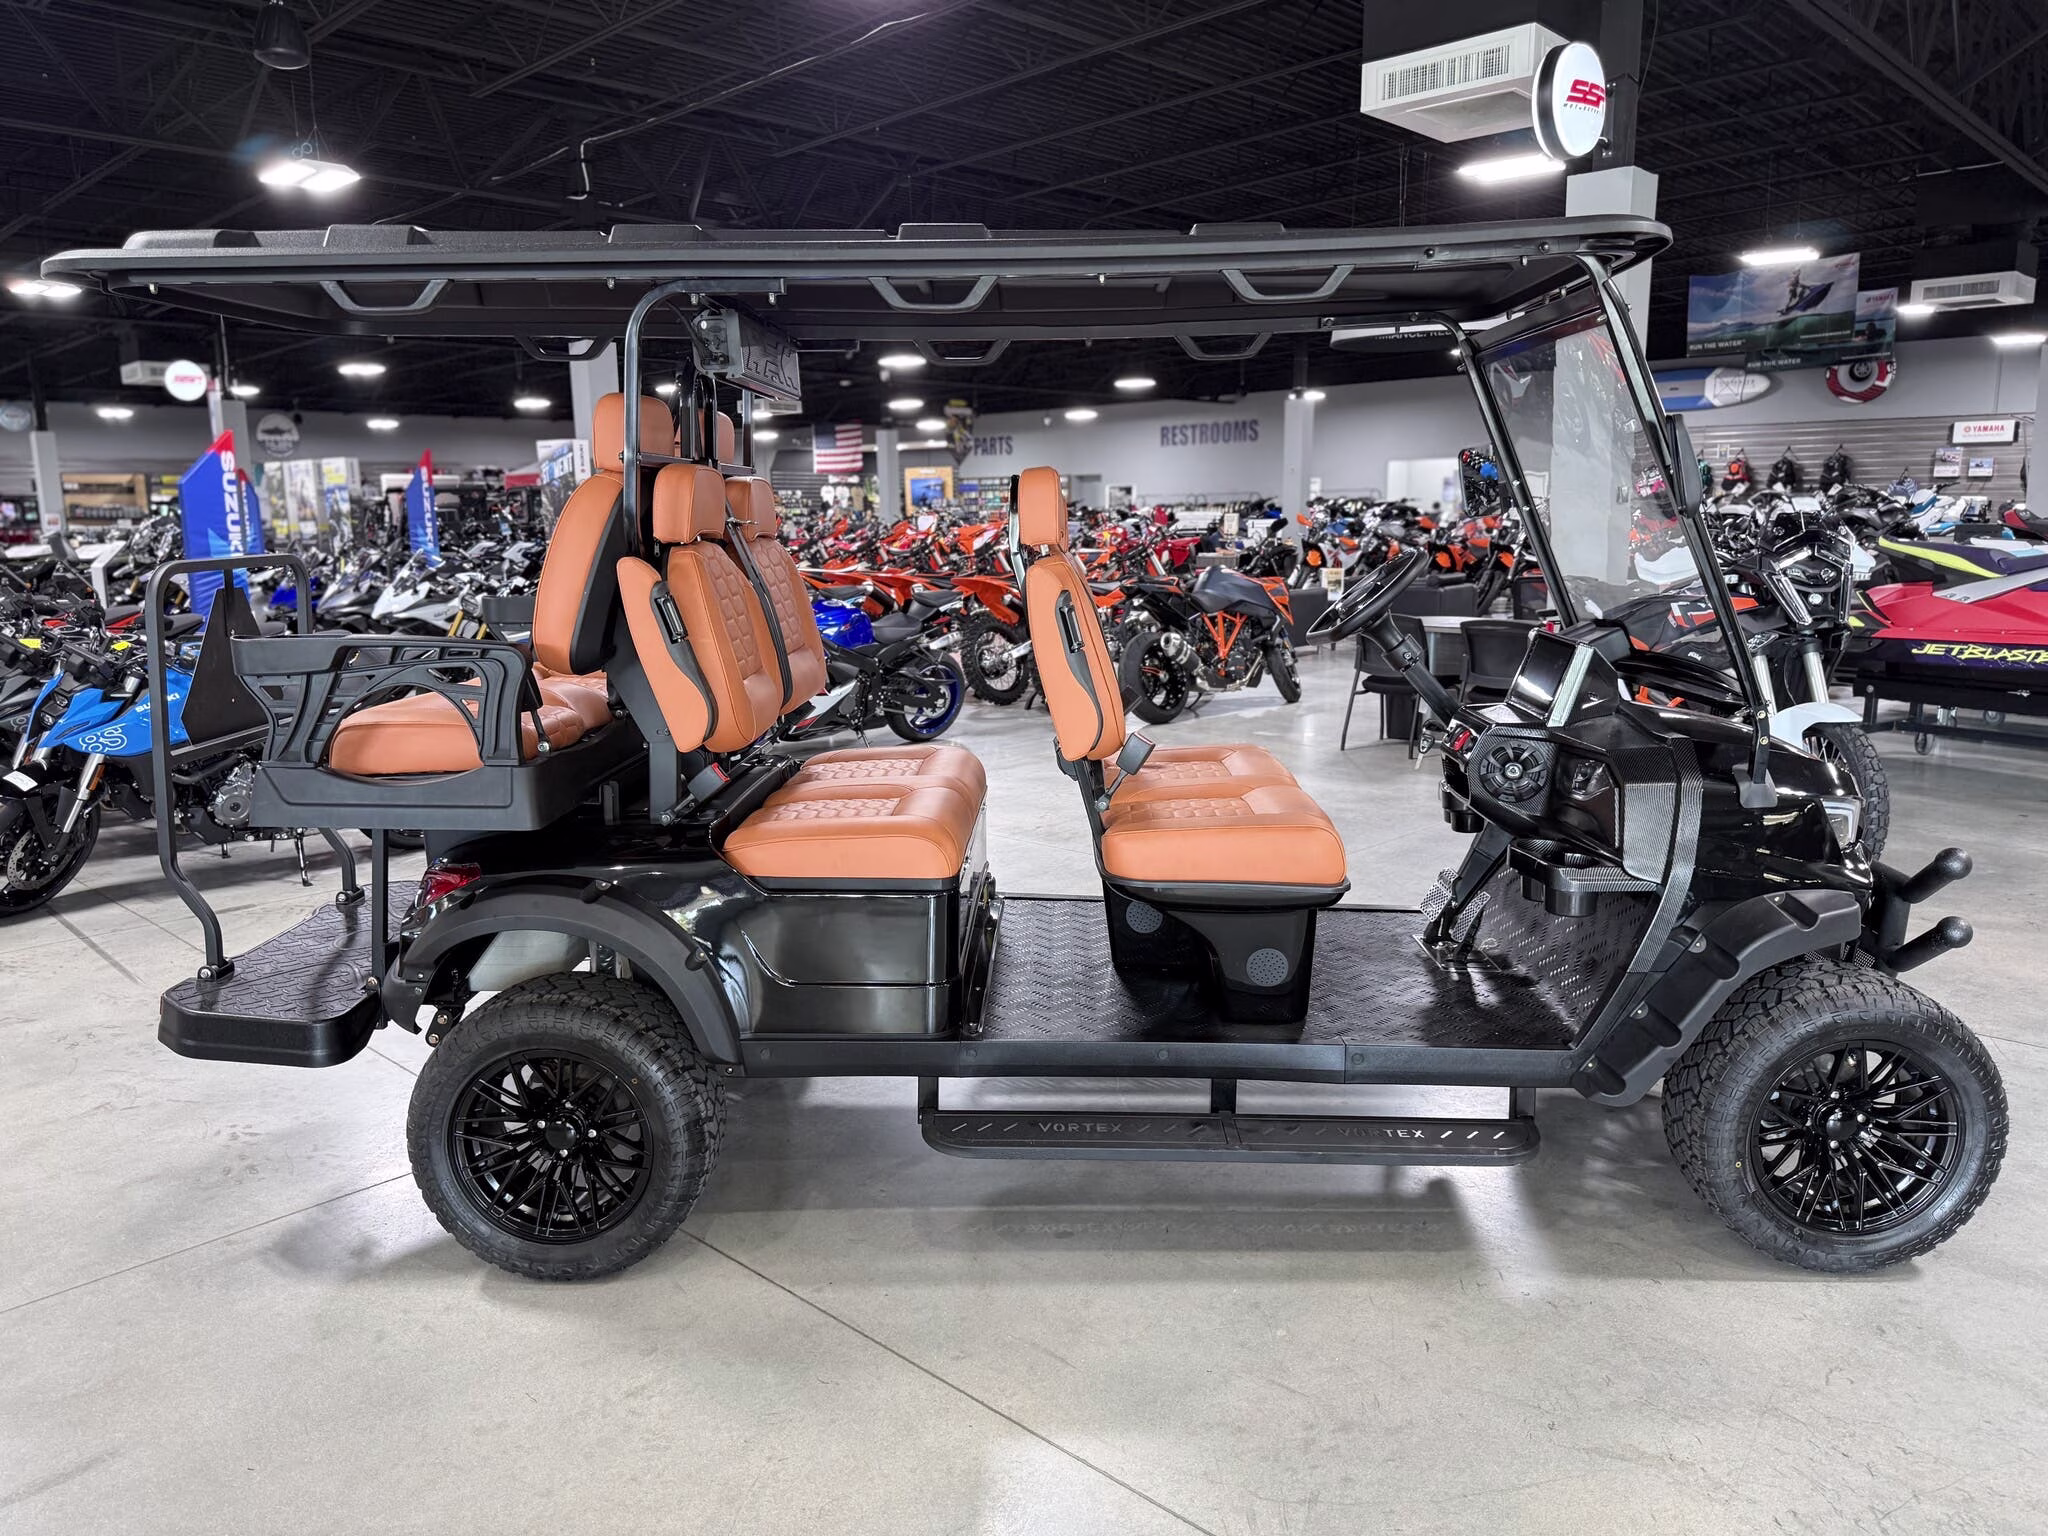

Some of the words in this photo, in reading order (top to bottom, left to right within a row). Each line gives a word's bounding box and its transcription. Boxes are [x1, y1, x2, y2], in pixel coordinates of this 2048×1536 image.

[1160, 418, 1259, 446] RESTROOMS
[1973, 424, 2005, 433] YAMAHA
[973, 435, 1014, 456] PARTS
[1038, 1122, 1122, 1133] VORTEX
[1337, 1127, 1425, 1138] VORTEX
